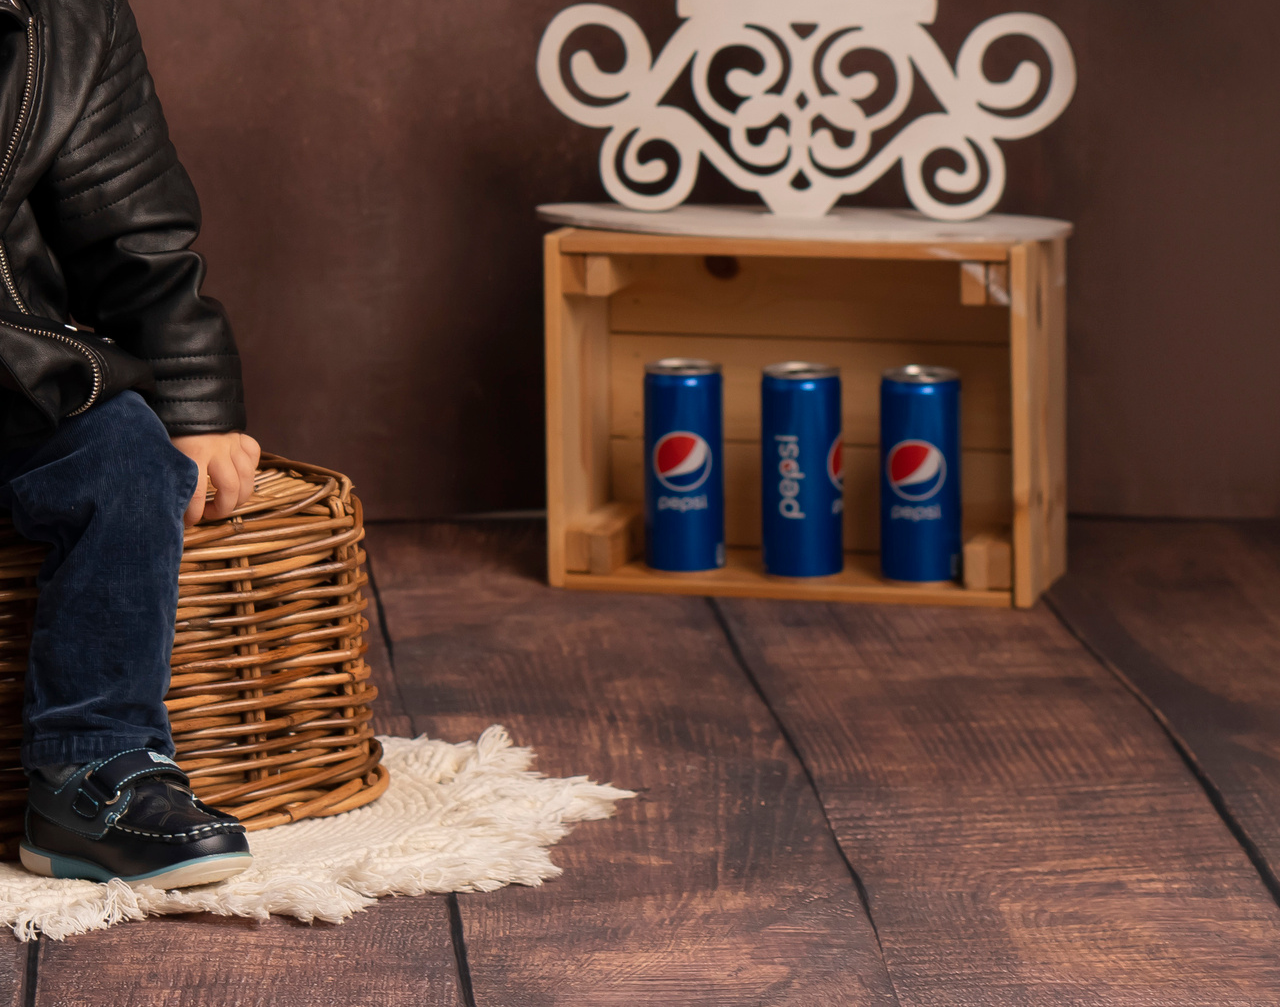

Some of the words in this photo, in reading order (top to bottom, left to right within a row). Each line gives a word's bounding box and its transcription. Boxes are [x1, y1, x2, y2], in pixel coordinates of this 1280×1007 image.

[774, 434, 805, 520] pepsi
[657, 493, 708, 512] pepsi
[891, 502, 942, 522] pepsi
